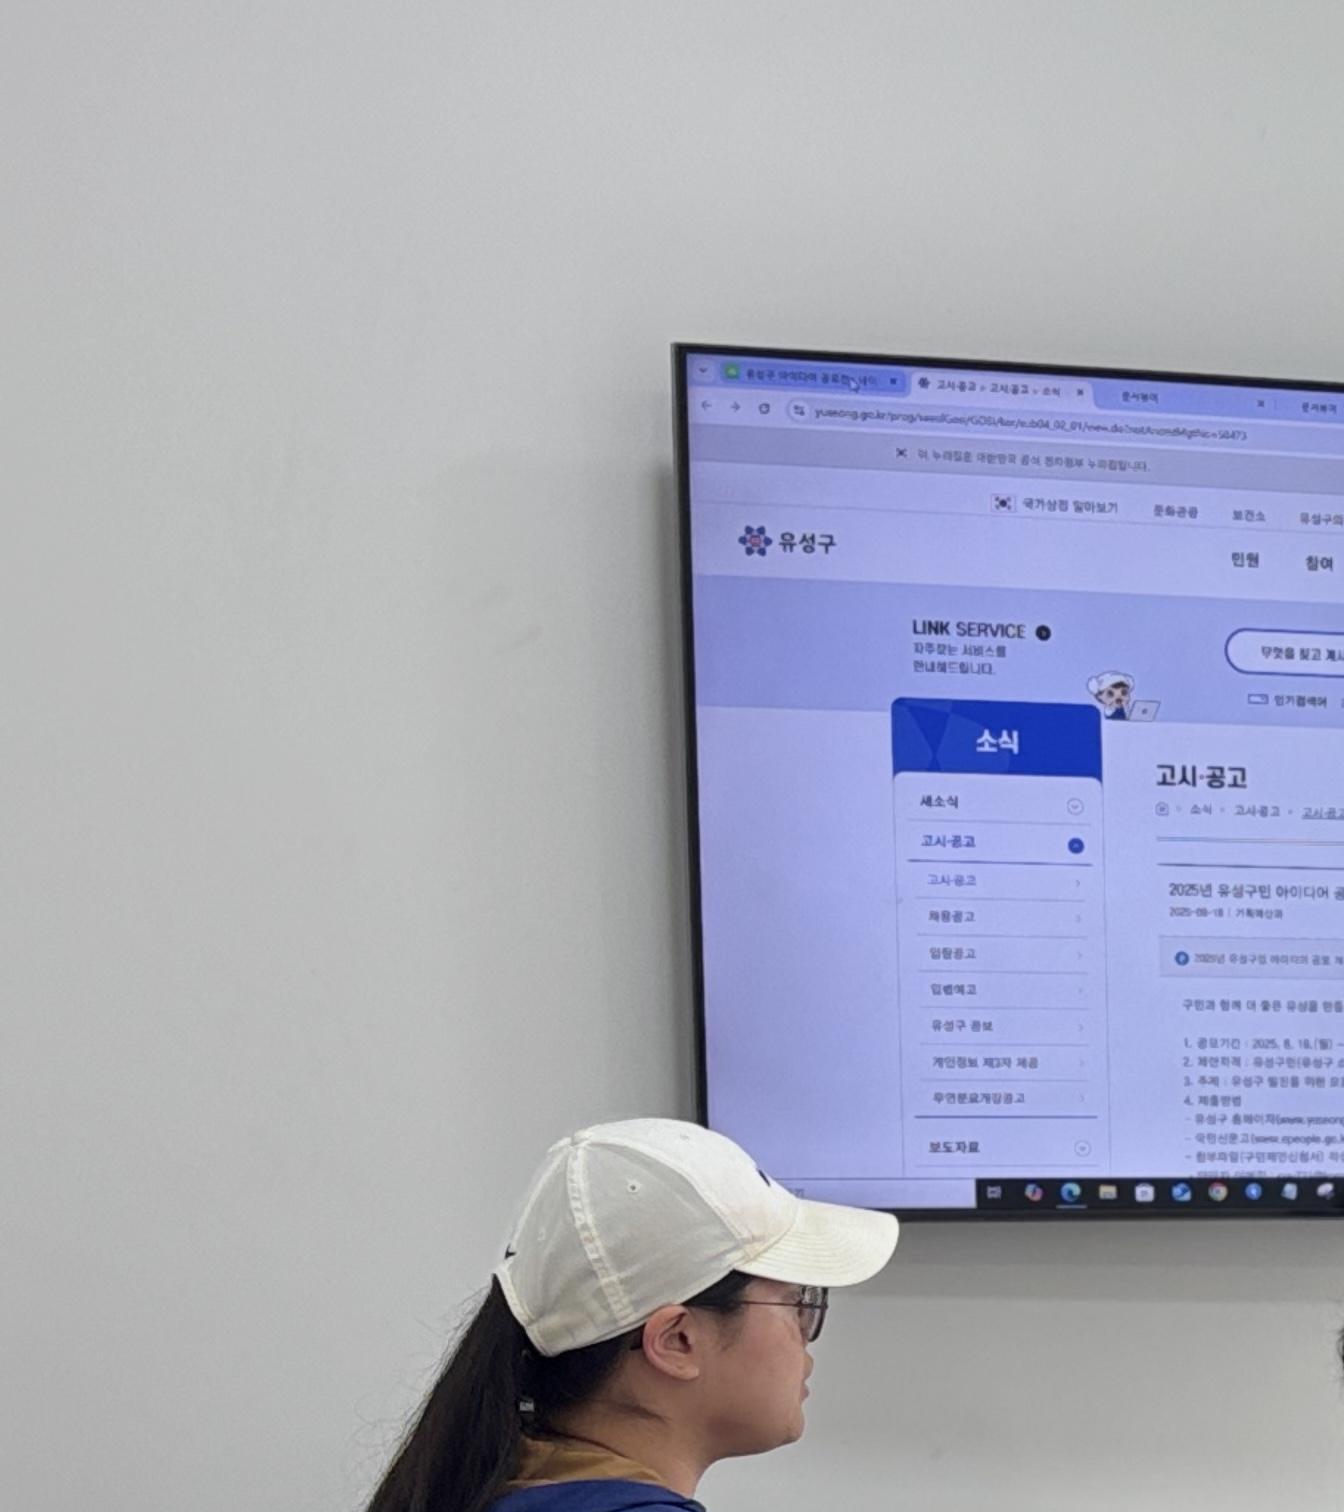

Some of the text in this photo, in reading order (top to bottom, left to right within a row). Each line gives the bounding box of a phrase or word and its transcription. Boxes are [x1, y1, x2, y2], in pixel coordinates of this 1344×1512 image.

[1153, 503, 1199, 519] 문화관광
[1232, 508, 1267, 523] 보건소
[778, 531, 838, 556] 유성구
[1231, 551, 1260, 569] 민원
[1306, 555, 1334, 572] 참여
[912, 619, 1026, 639] LINK SERVICE
[962, 643, 1007, 658] 서비스를
[1261, 645, 1296, 660] 무엇을
[1299, 647, 1322, 661] 찾고
[976, 728, 1020, 755] 소식
[1156, 764, 1248, 789] 고시·공고
[920, 793, 959, 810] 새소식
[1190, 802, 1213, 816] 소식
[1169, 882, 1213, 898] 2025년
[1217, 883, 1272, 900] 유성구민
[1275, 884, 1329, 900] 아이디어
[929, 1140, 980, 1154] 보도자료
